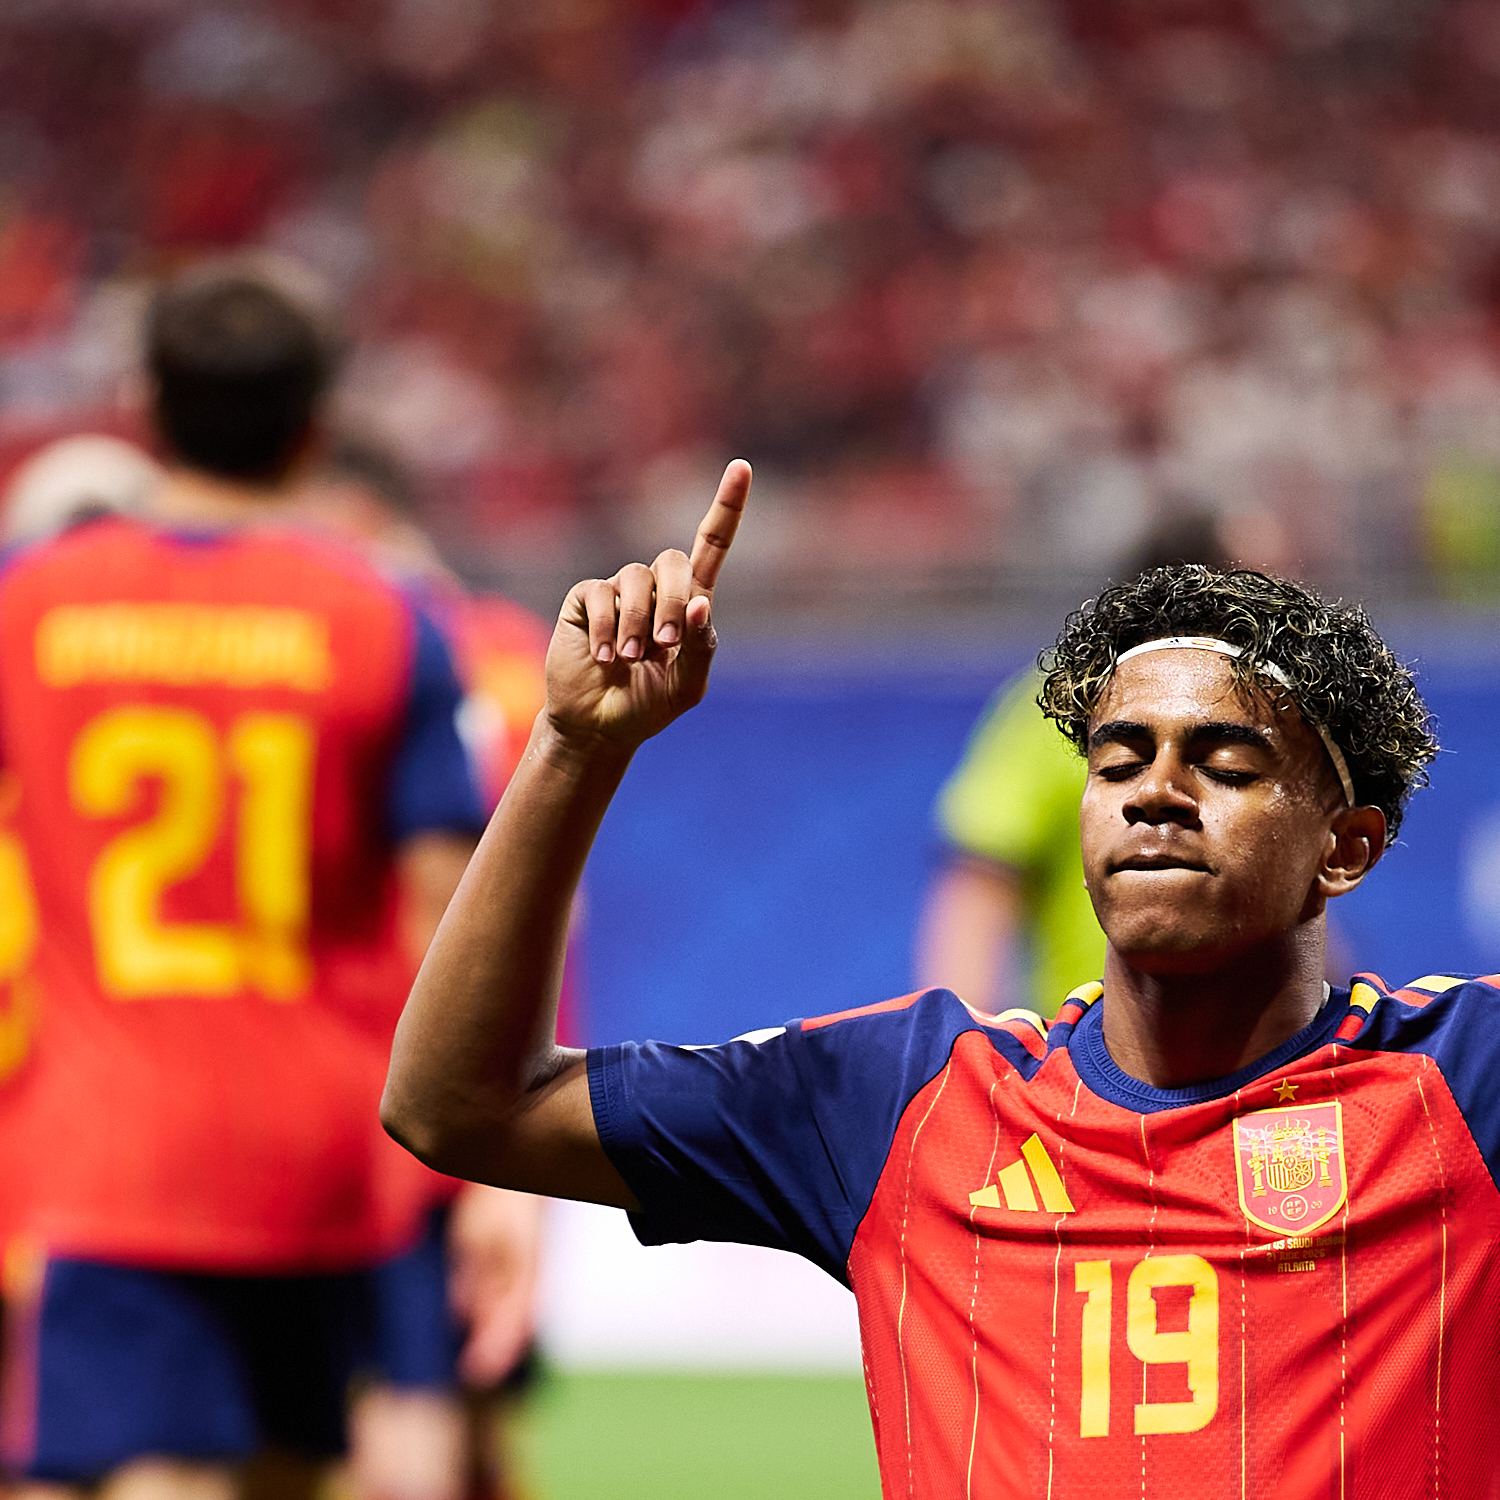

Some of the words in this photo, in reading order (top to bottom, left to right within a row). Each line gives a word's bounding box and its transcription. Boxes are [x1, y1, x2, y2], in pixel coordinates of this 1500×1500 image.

[68, 706, 316, 1002] 21
[1287, 1237, 1313, 1249] SAUDI
[1303, 1248, 1326, 1259] 2026
[1278, 1260, 1316, 1273] ATLANTA
[1074, 1254, 1219, 1438] 19
